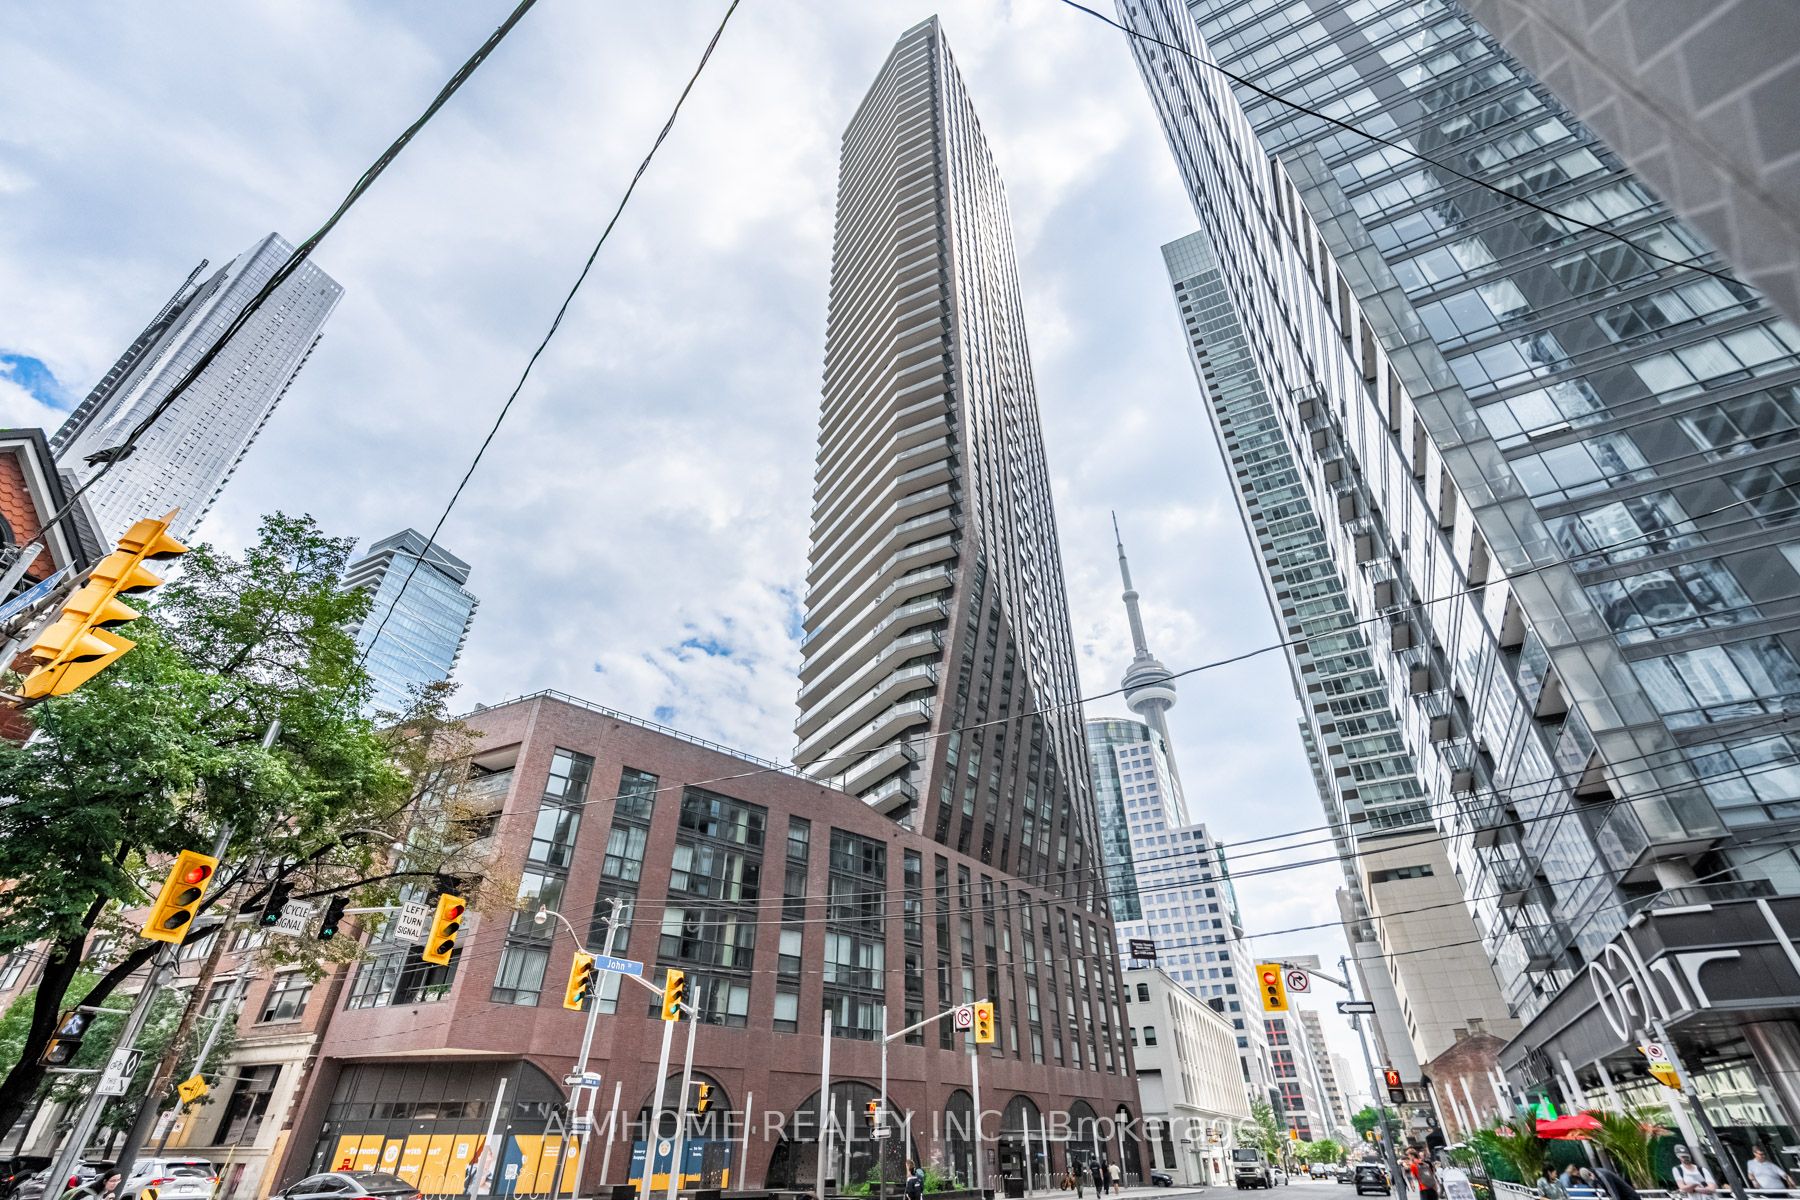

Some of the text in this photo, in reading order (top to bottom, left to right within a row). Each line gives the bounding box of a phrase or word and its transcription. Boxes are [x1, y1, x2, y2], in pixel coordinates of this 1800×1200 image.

[405, 904, 425, 916] LEFT
[402, 915, 423, 927] TURN
[397, 925, 420, 938] SIGNAL
[607, 959, 625, 971] John
